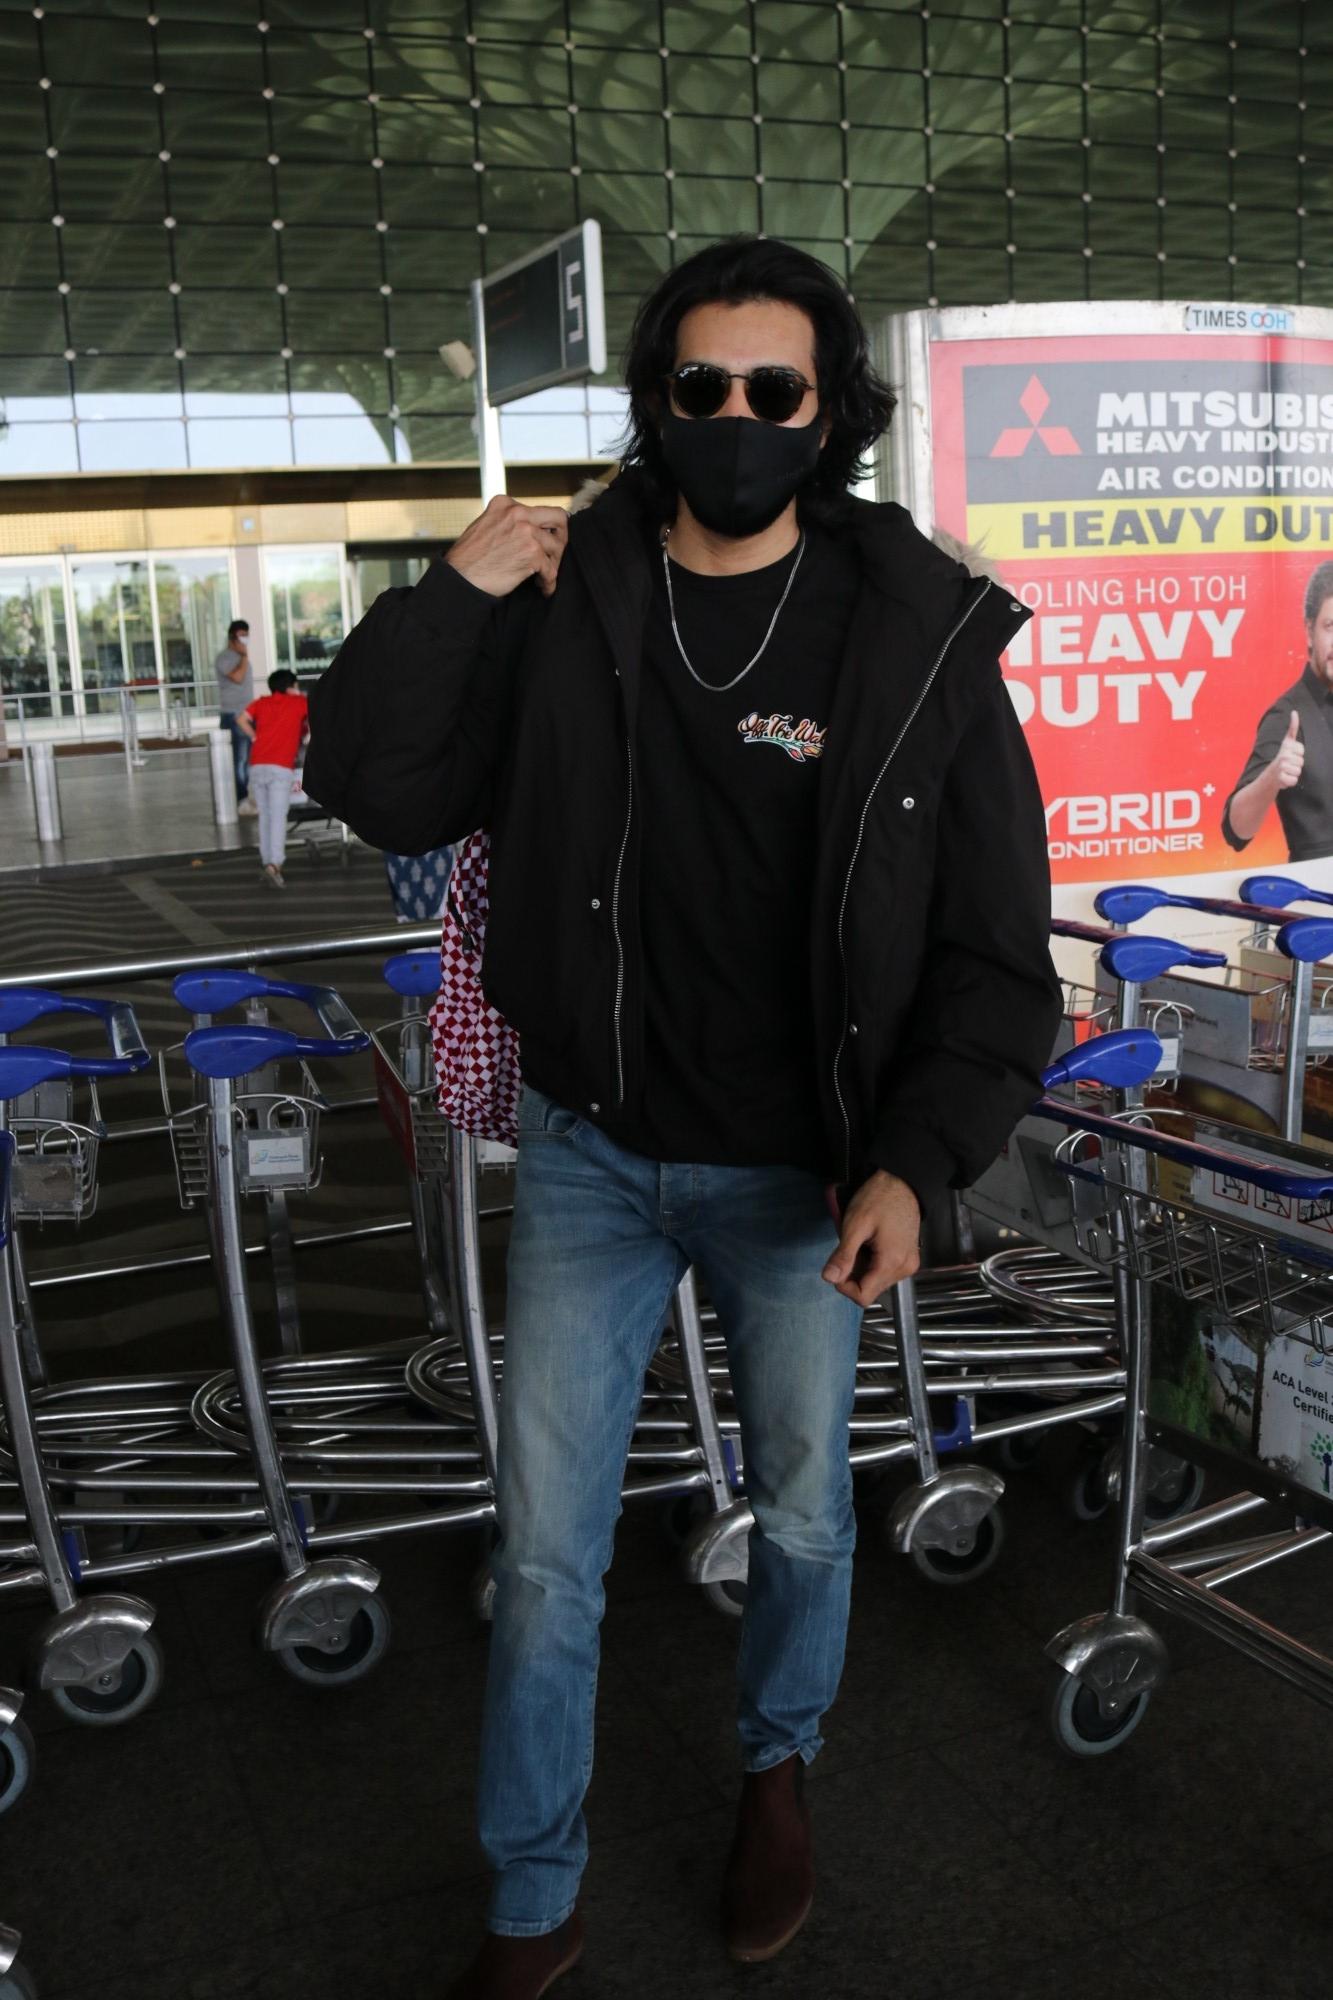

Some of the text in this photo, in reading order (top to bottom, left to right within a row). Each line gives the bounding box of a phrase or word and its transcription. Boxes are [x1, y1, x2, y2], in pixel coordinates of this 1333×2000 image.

[1192, 309, 1287, 330] TIMES OOH
[1096, 430, 1212, 454] HEAVY
[1097, 465, 1333, 491] AIR CONDITION
[1022, 504, 1333, 549] HEAVY DUT
[1003, 575, 1247, 609] OLING HO TOH
[1272, 1370, 1295, 1389] ACA
[1298, 1380, 1328, 1404] Level
